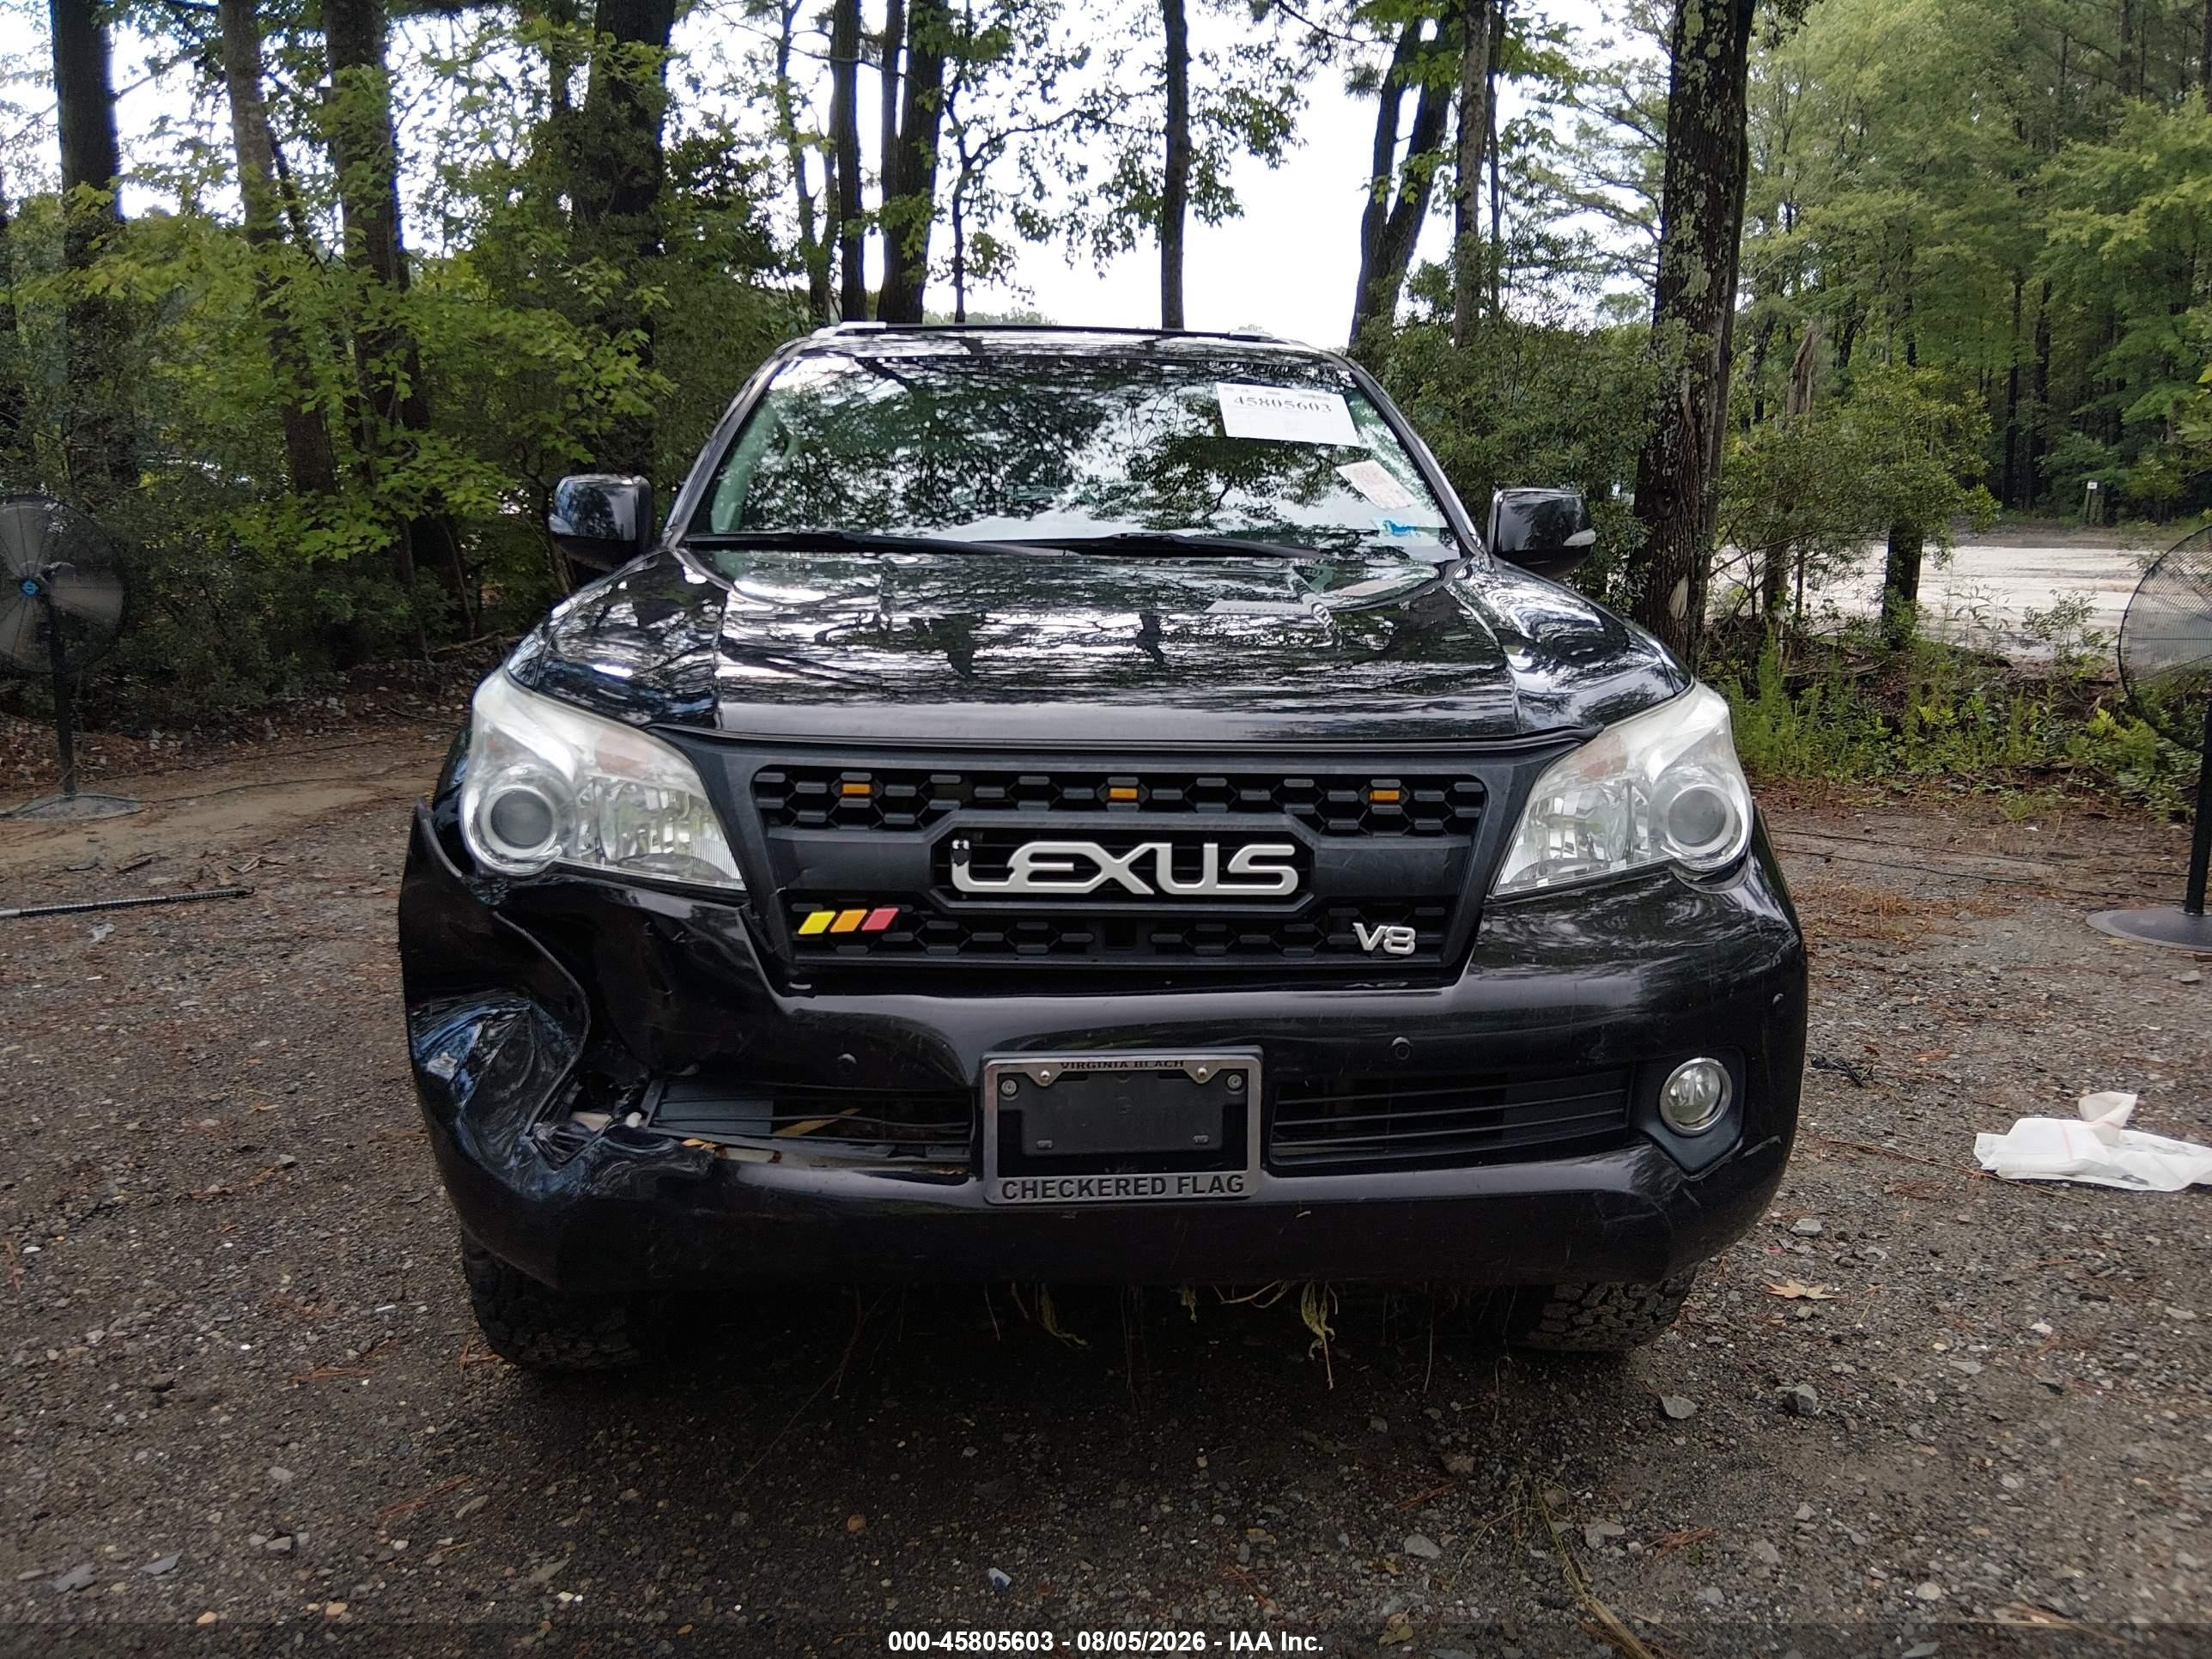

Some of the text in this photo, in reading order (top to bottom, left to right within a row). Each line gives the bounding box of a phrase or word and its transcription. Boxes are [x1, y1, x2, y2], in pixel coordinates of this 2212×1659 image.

[1233, 395, 1332, 414] 45805603
[951, 840, 1298, 896] LEXUS
[1352, 922, 1416, 955] V8
[1060, 1061, 1129, 1070] VIRGINIA
[1001, 1173, 1245, 1200] CHECKERED FLAG
